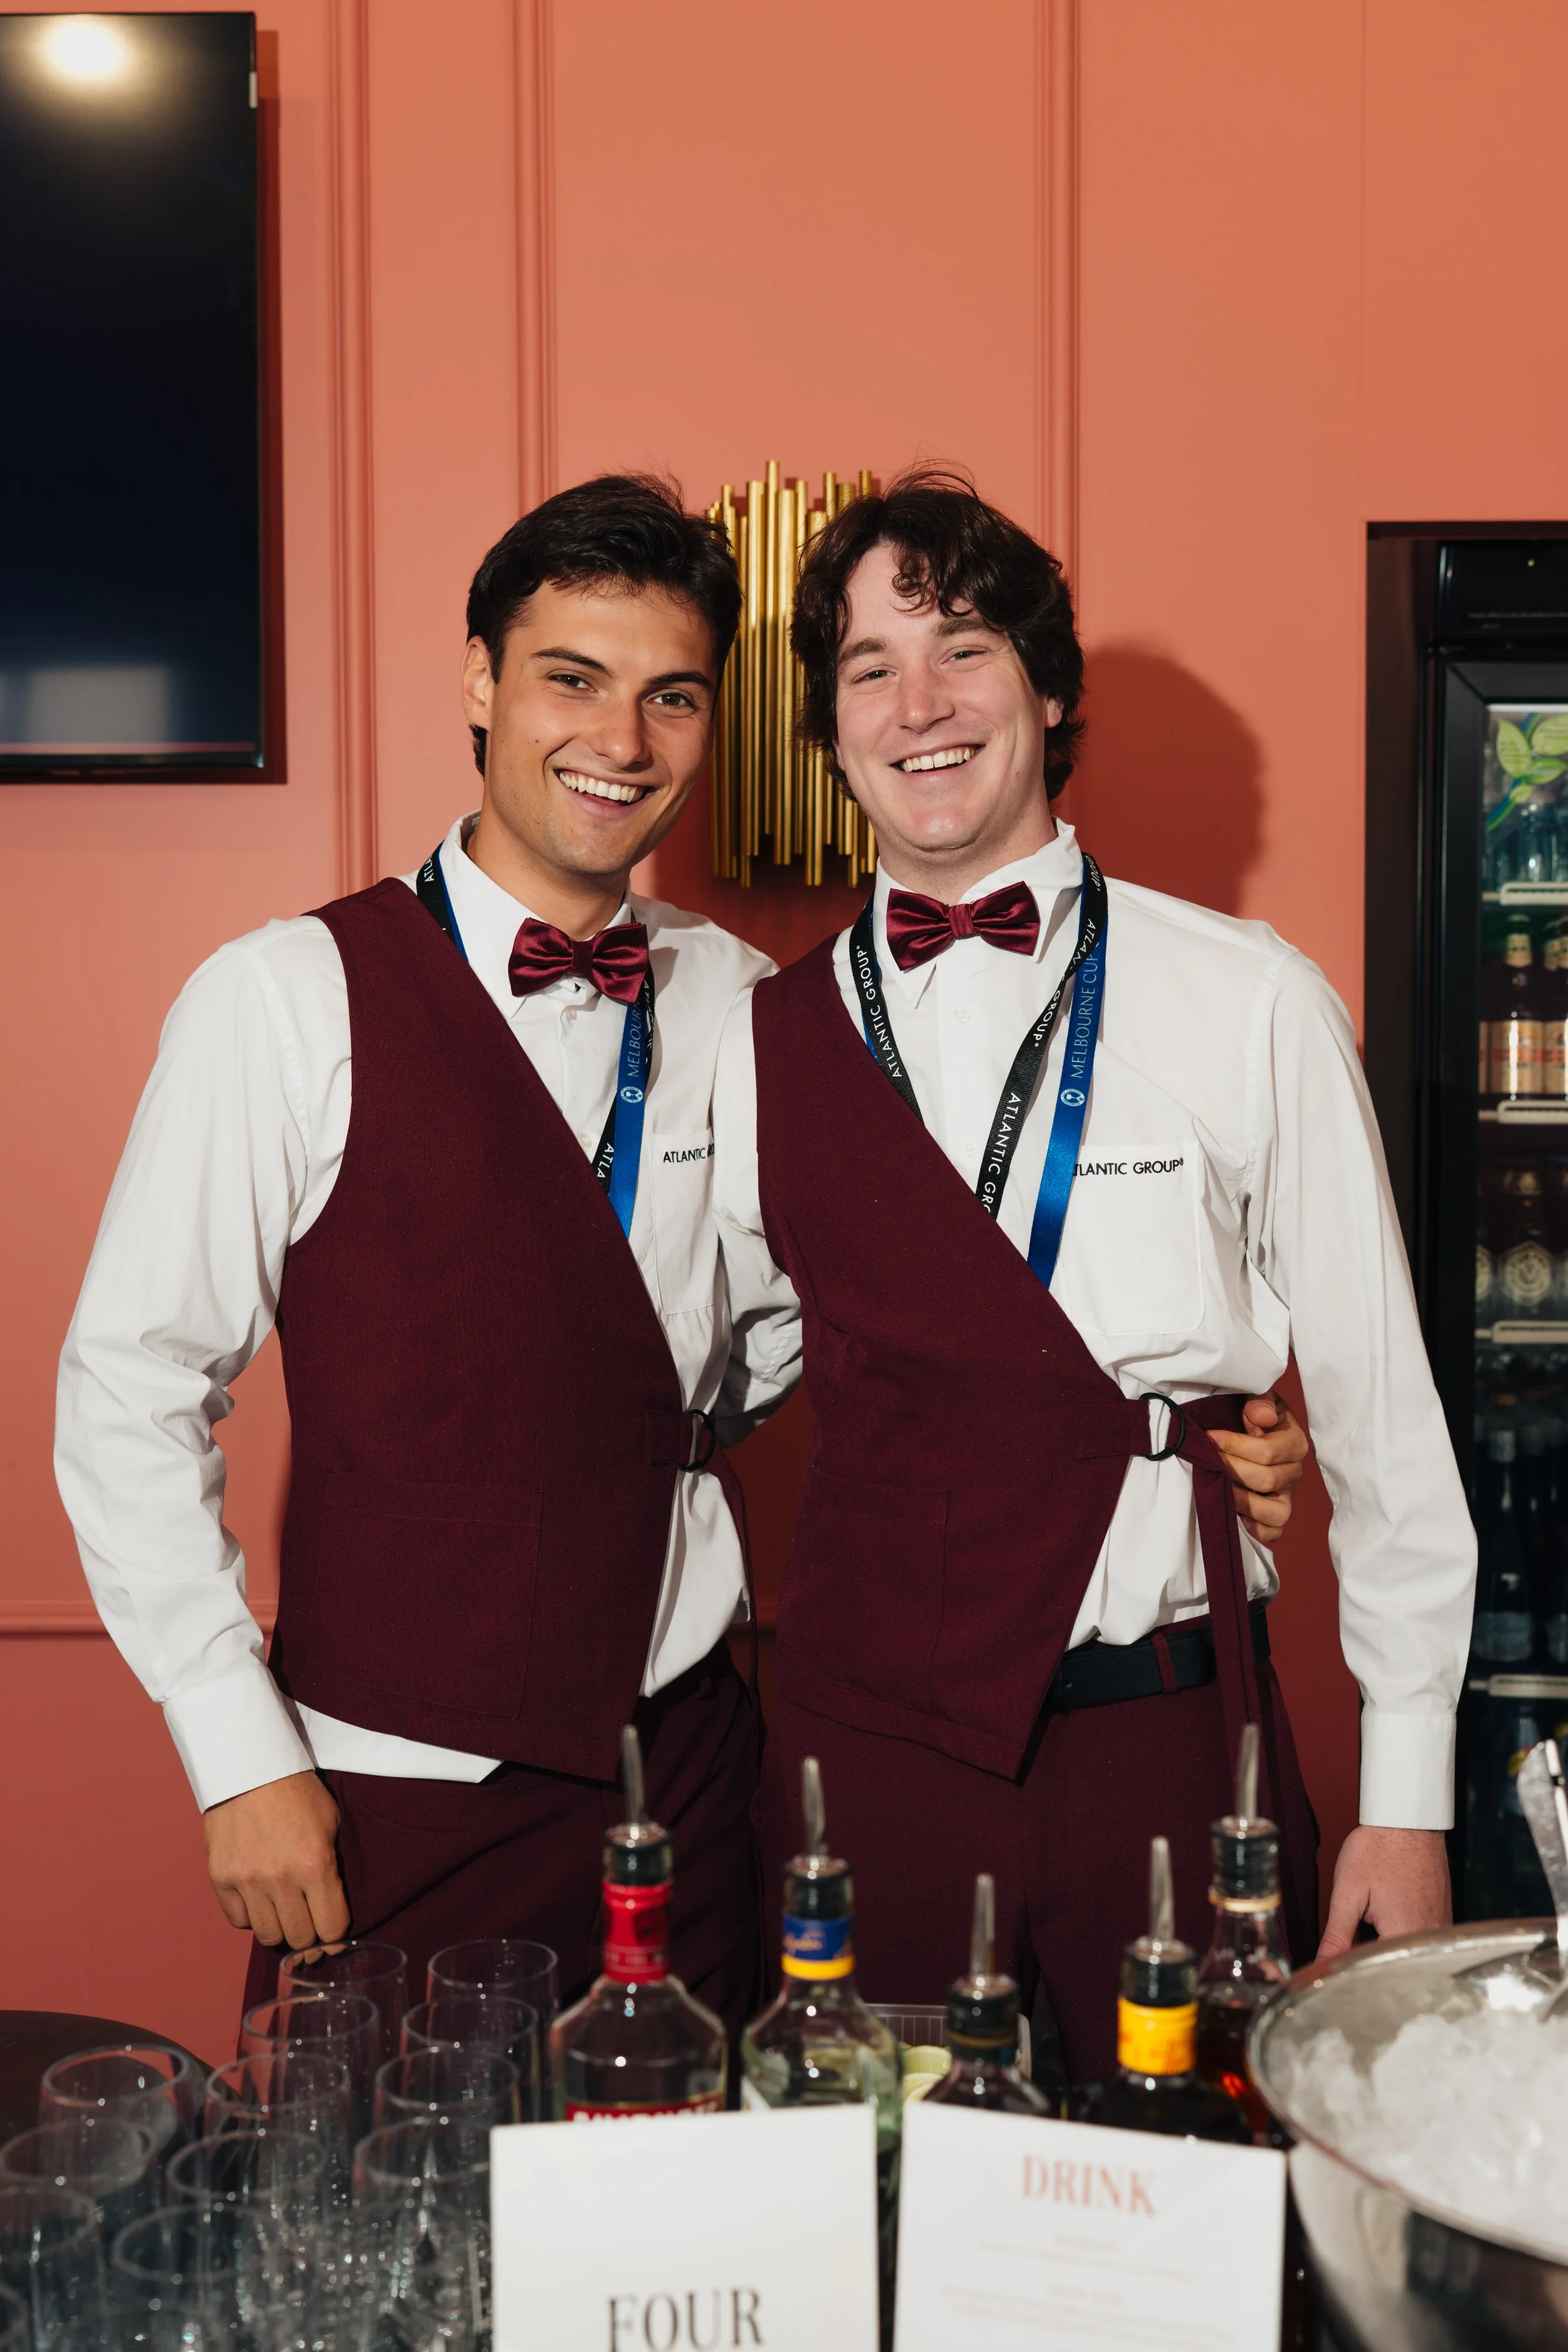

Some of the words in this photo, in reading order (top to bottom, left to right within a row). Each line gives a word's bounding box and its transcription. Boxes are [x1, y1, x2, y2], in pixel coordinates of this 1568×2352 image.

[870, 1005, 902, 1078] ATLANTIC
[1070, 987, 1096, 1079] MELBOURNE
[663, 1147, 706, 1163] ATLANTIC
[988, 1092, 1022, 1175] ATLANTIC
[1073, 1162, 1128, 1177] TLANTIC
[1021, 2154, 1157, 2217] DRINK
[606, 2286, 764, 2352] FOUR
